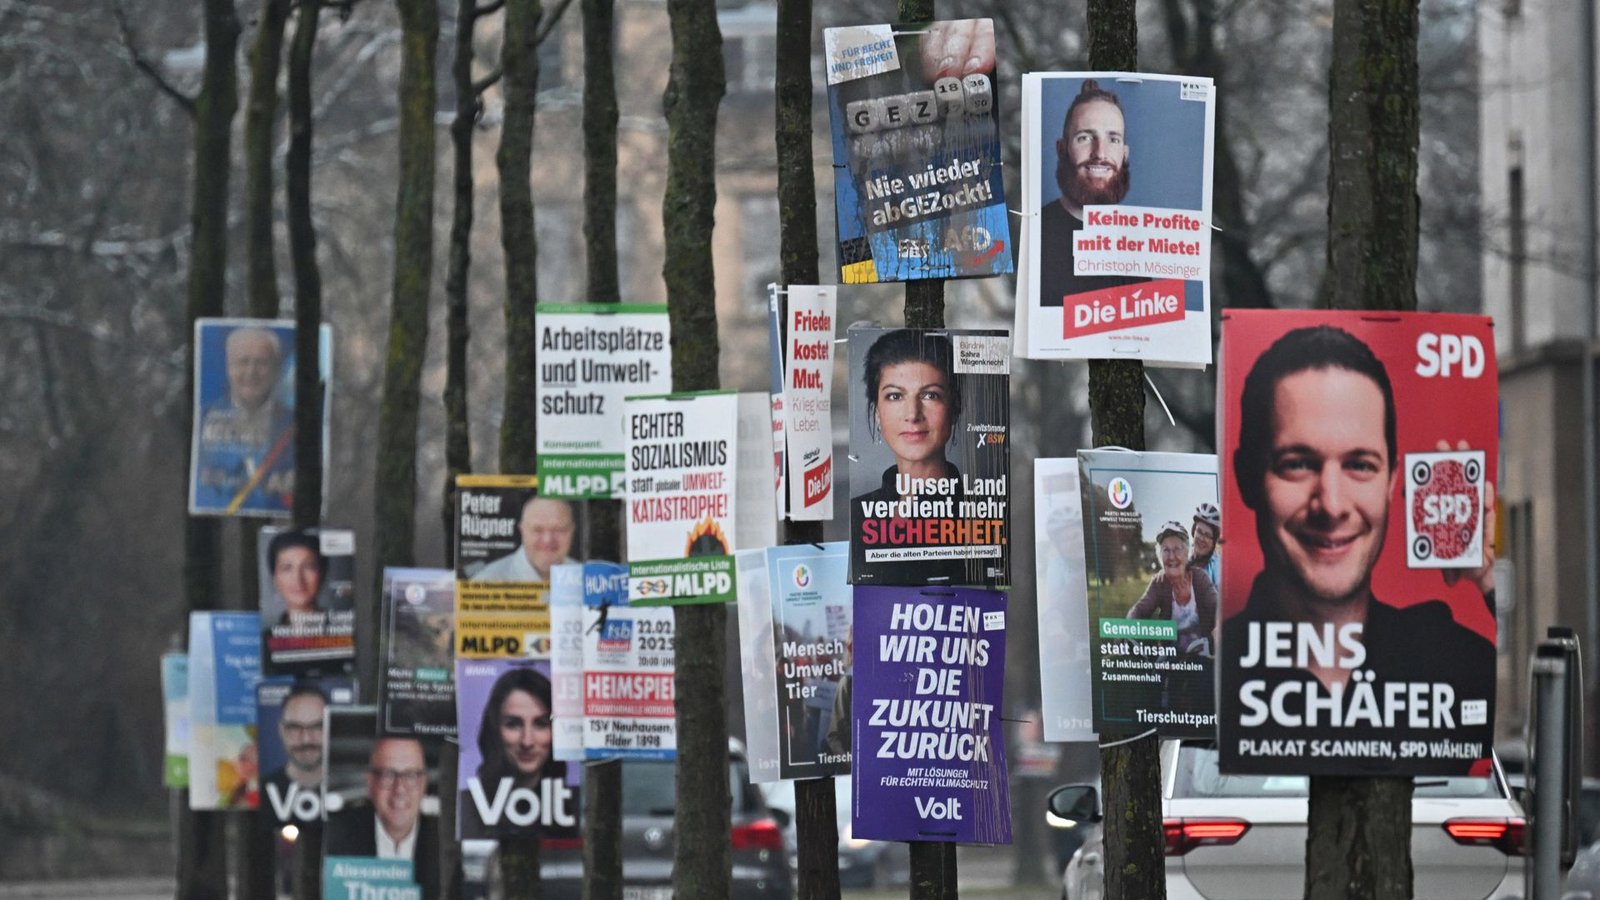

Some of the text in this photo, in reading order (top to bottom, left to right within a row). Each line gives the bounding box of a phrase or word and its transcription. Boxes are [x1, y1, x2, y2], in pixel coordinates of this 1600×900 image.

[832, 51, 893, 73] UND FREIHEIT
[842, 46, 861, 58] FÜR
[939, 79, 985, 94] 18 36
[855, 102, 930, 127] GEZ
[865, 159, 981, 201] Nie wieder
[873, 181, 993, 226] abGEZockt!
[1088, 211, 1200, 231] Keine Profite
[943, 226, 991, 252] AfD
[1078, 236, 1200, 255] mit der Miete!
[1077, 260, 1200, 278] Christoph Mössinger
[1074, 289, 1178, 329] Die Linke
[542, 327, 663, 355] Arbeitsplätze
[960, 350, 980, 358] Sahra
[960, 358, 1004, 367] Wagenknecht
[1415, 332, 1485, 378] SPD
[542, 359, 659, 383] und Umwelt-
[793, 368, 823, 392] Mut,
[542, 391, 605, 415] schutz
[793, 398, 815, 415] Krieg
[632, 412, 684, 440] ECHTER
[988, 433, 1006, 444] BSW
[632, 440, 727, 471] SOZIALISMUS
[544, 474, 608, 495] MLPD
[631, 477, 653, 493] statt
[683, 472, 726, 492] UMWELT-
[808, 476, 821, 498] Die
[896, 473, 1006, 496] Unser Land
[461, 492, 502, 515] Peter
[632, 494, 728, 523] KATASTROPHE!
[861, 498, 1006, 518] verdient mehr
[1422, 493, 1472, 525] SPD
[461, 515, 515, 538] Rügner
[862, 519, 1007, 545] SICHERHEIT.
[871, 551, 888, 559] Aber
[890, 550, 902, 558] die
[923, 549, 952, 557] Parteien
[632, 560, 729, 576] Internationalistische Liste
[674, 571, 732, 597] MLPD
[890, 603, 981, 633] HOLEN
[1102, 621, 1174, 637] Gemeinsam
[461, 636, 520, 655] MLPD
[783, 639, 843, 657] Mensch
[880, 635, 990, 667] WIR UNS
[1100, 642, 1177, 656] statt einsam
[1239, 621, 1366, 670] JENS
[784, 659, 845, 679] Umwelt
[1102, 659, 1203, 671] Für Inklusion und sozialen
[915, 668, 962, 696] DIE
[1102, 672, 1161, 682] Zusammenhalt
[786, 684, 818, 700] Tier
[1239, 670, 1456, 729] SCHÄFER
[868, 698, 993, 731] ZUKUNFT
[590, 719, 673, 734] TSV Neuhausen,
[605, 735, 632, 747] Filder
[876, 727, 989, 763] ZURÜCK
[1239, 739, 1482, 760] PLAKAT SCANNEN, SPD WÄHLEN!
[818, 751, 852, 765] Tiersch
[880, 776, 989, 789] FÜR ECHTEN KLIMASCHUTZ
[907, 767, 969, 779] MIT LÖSUNGEN
[467, 777, 576, 826] Volt
[914, 797, 962, 820] Volt
[332, 863, 411, 879] Alexander
